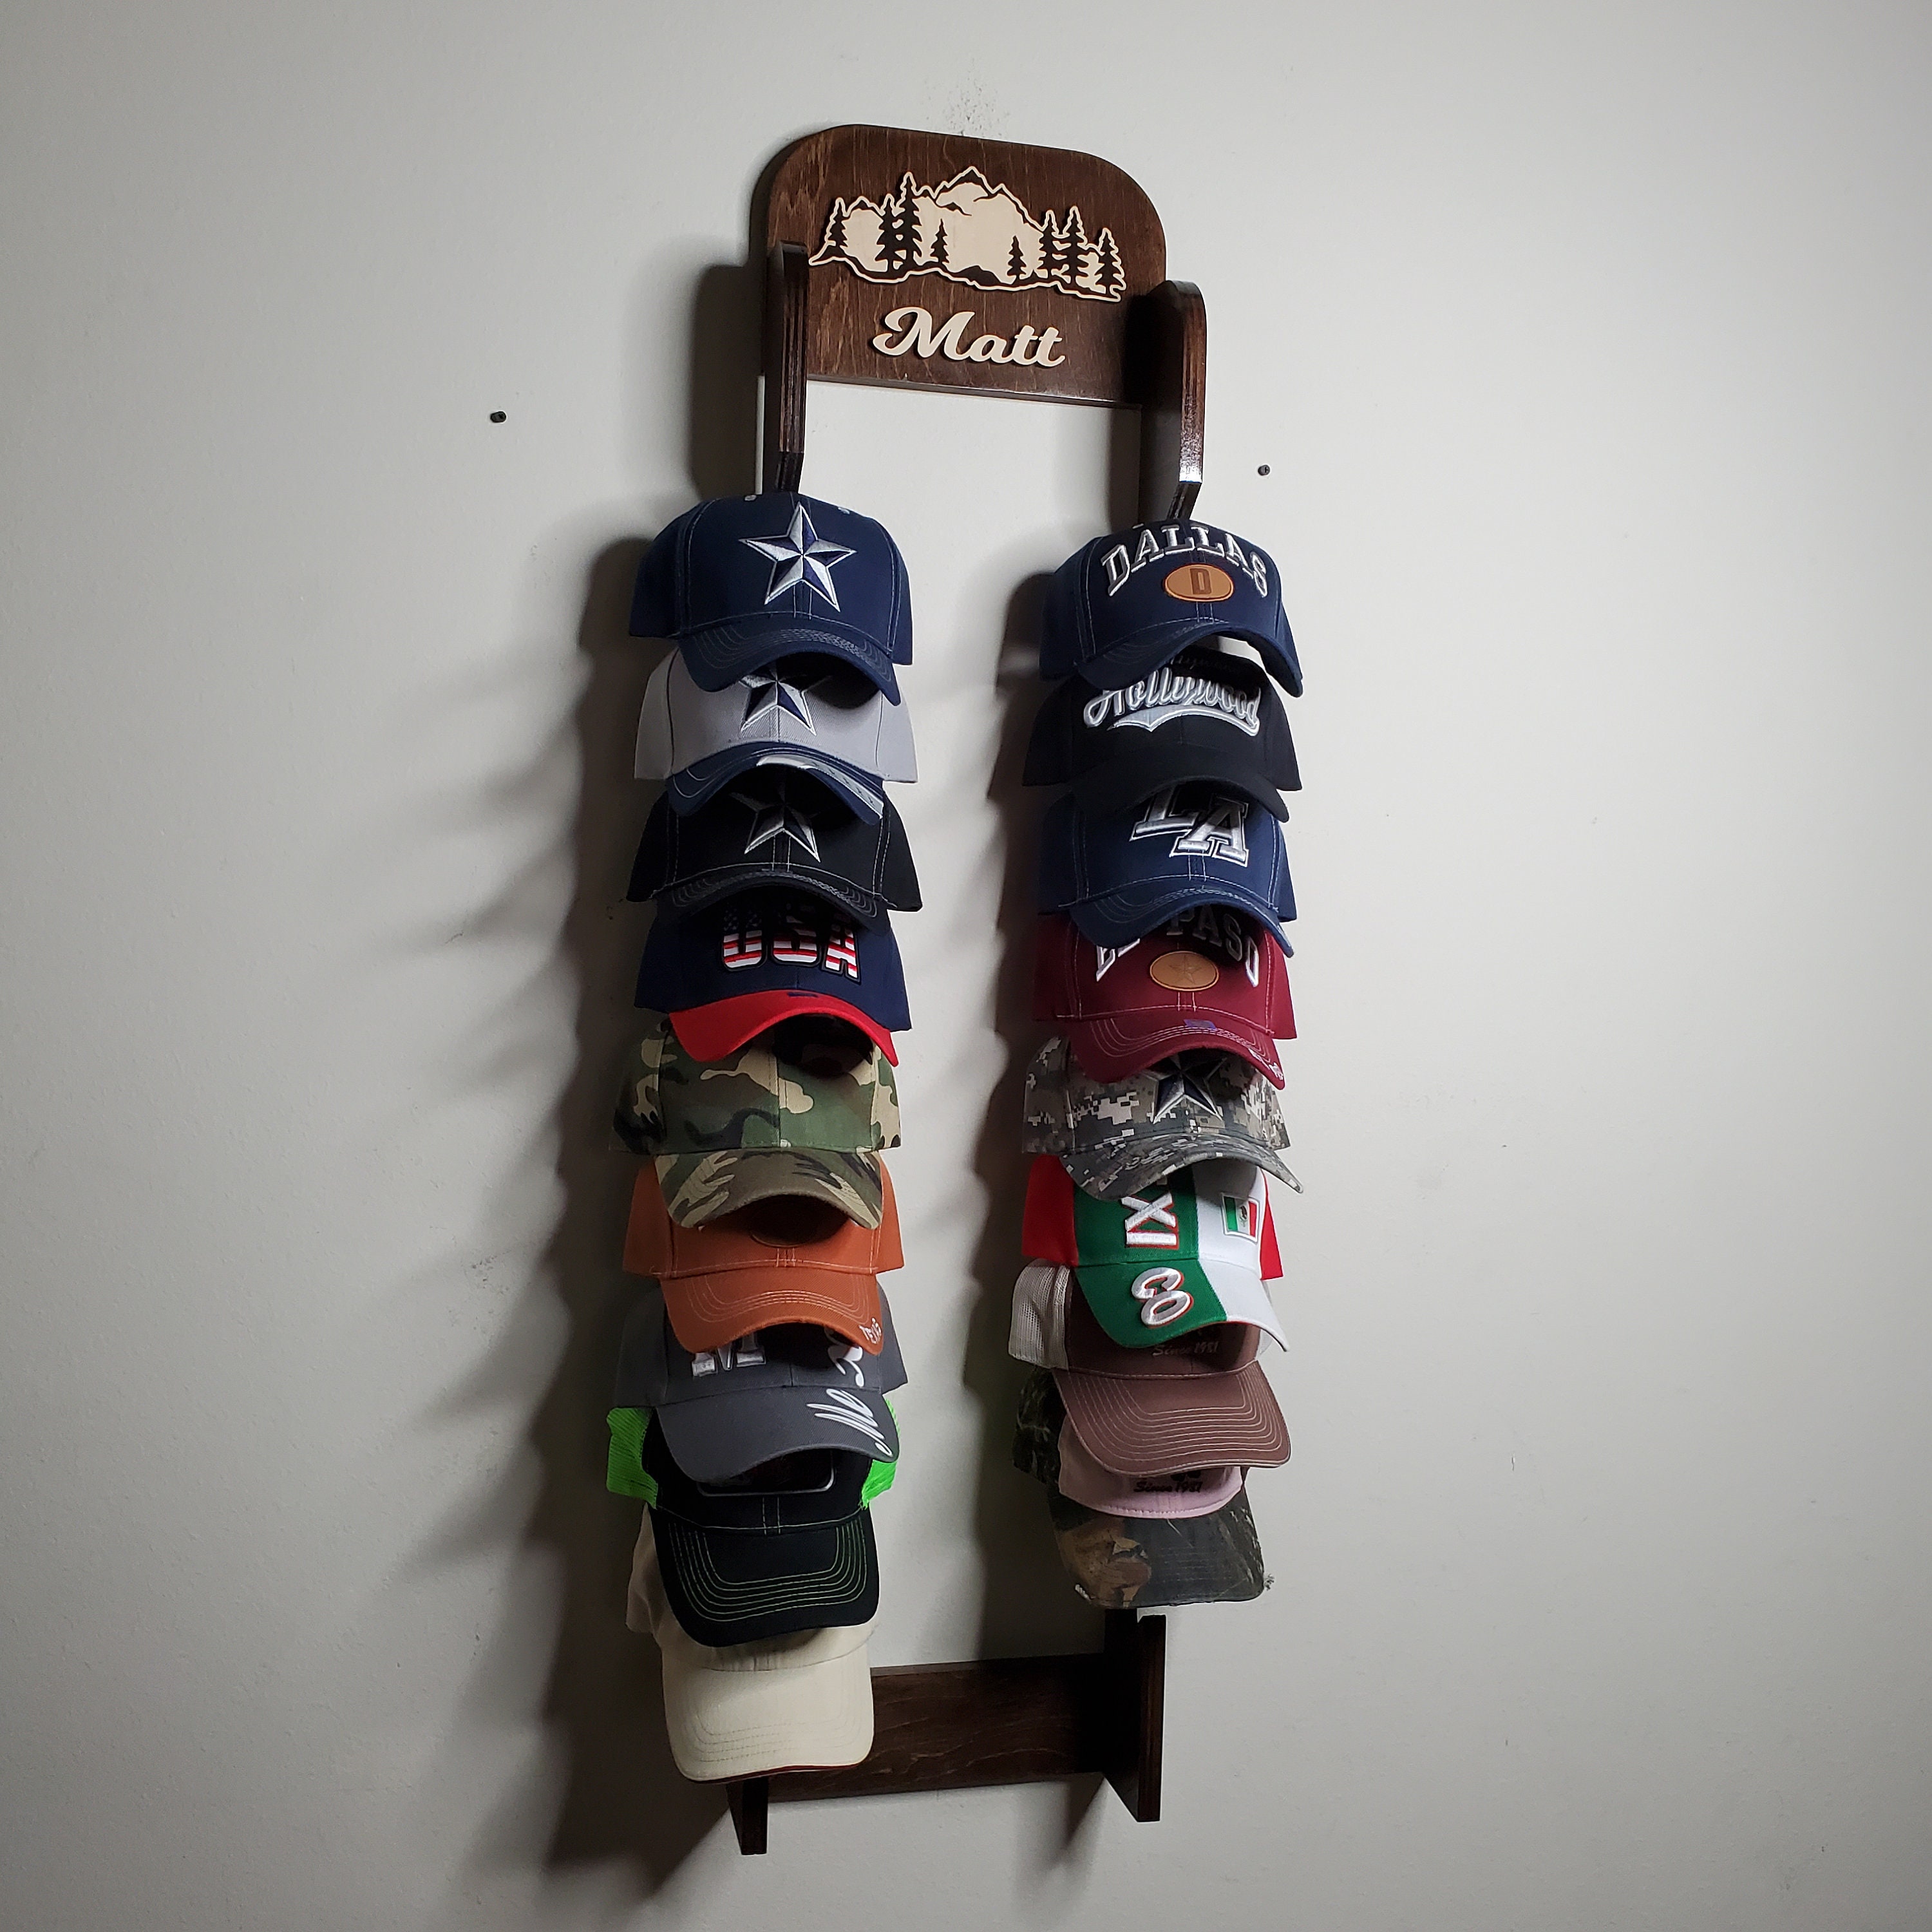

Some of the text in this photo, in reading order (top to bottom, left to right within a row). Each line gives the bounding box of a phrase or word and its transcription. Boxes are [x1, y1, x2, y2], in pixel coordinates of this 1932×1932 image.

[873, 307, 1065, 366] Matt
[1101, 523, 1267, 597] DALLAS
[1190, 568, 1213, 595] D
[1129, 784, 1249, 867] LA
[1121, 1191, 1194, 1328] XICO
